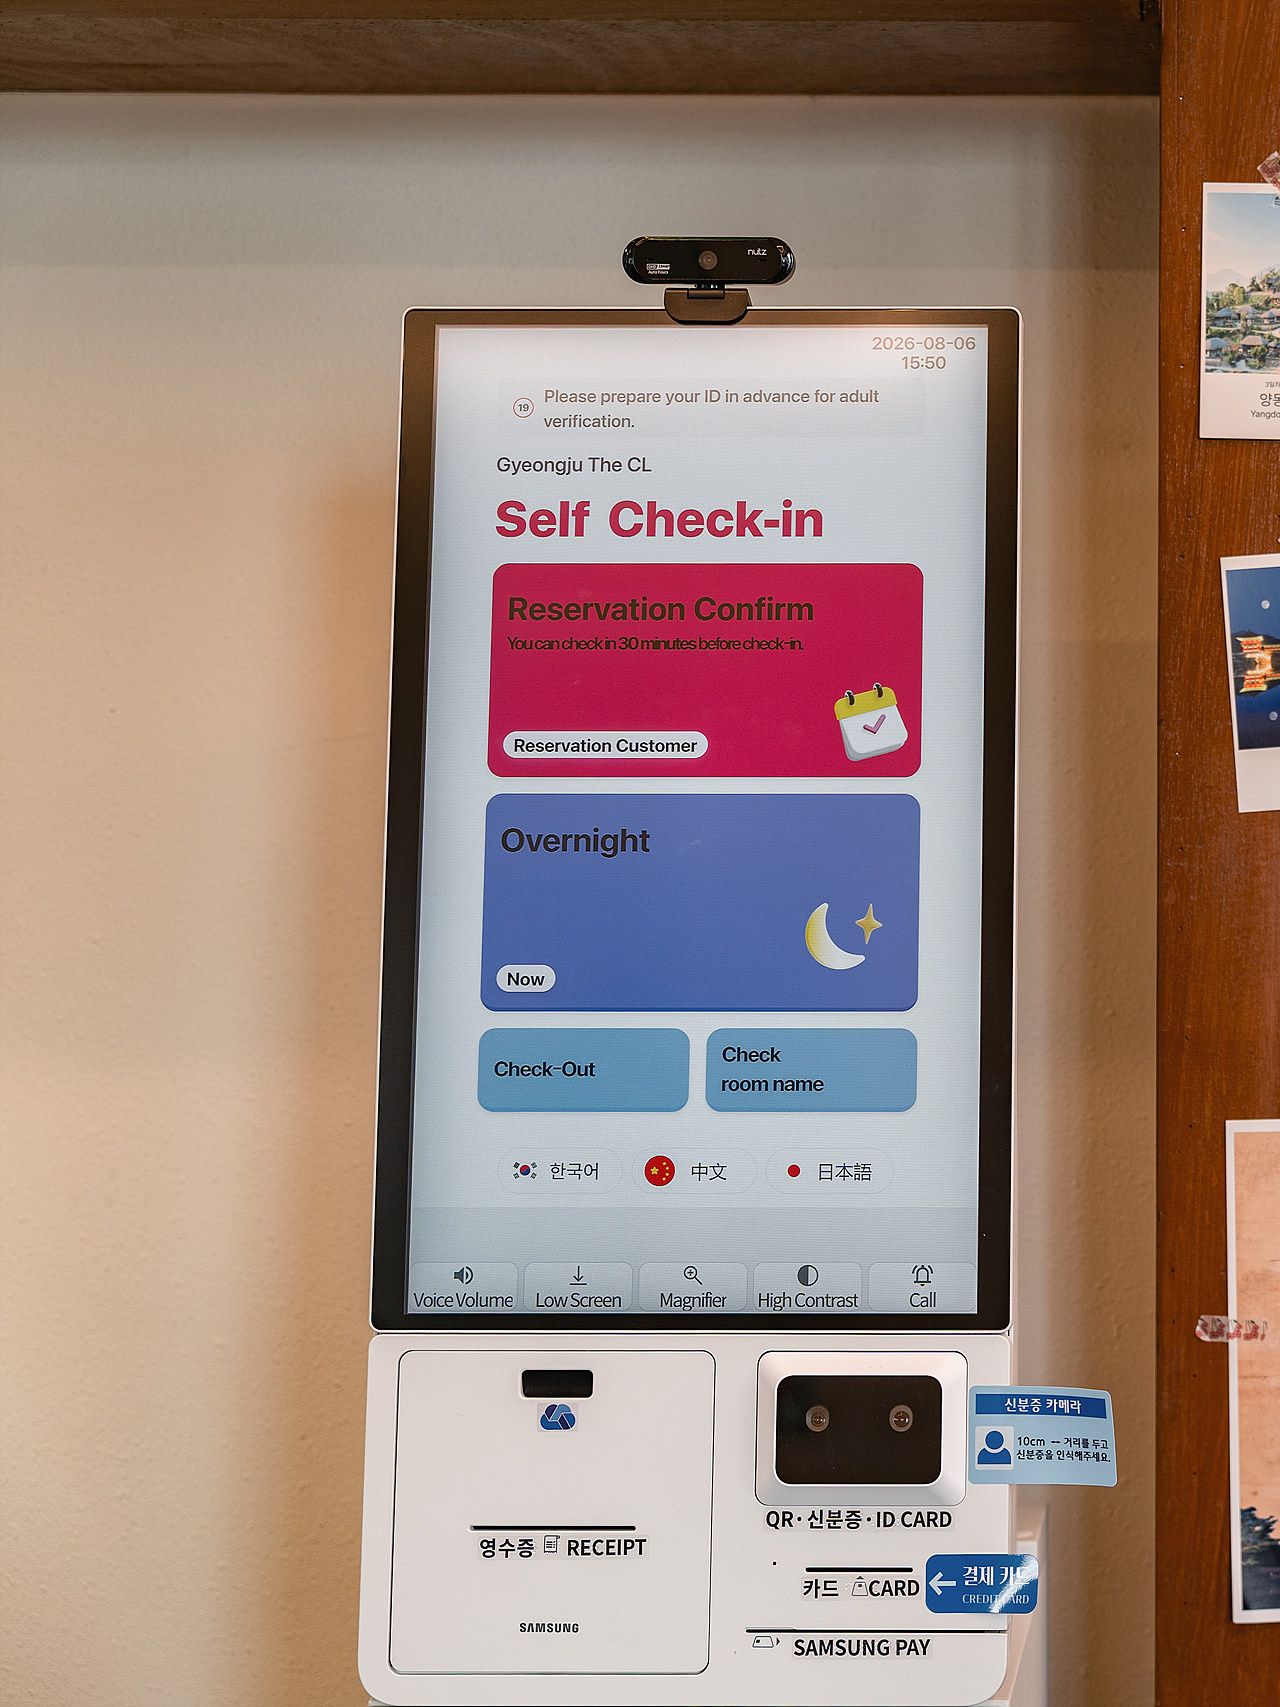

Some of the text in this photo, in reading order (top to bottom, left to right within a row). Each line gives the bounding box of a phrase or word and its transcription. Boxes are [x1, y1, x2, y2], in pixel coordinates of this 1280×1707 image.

[748, 248, 767, 256] nutz
[872, 336, 976, 351] 2026-08-06
[901, 355, 947, 370] 15:50
[544, 389, 879, 406] Please prepare your ID in advance for adult
[518, 403, 529, 412] 19
[544, 414, 635, 428] verification.
[497, 456, 652, 476] Gyeongju The CL
[496, 500, 824, 538] Self Check-in
[508, 596, 814, 621] Reservation Confirm
[507, 636, 533, 650] You
[534, 640, 560, 650] can
[562, 636, 603, 650] check
[604, 637, 616, 650] in
[618, 637, 638, 650] 30
[640, 637, 696, 650] minutes
[698, 636, 741, 650] before
[514, 738, 697, 754] Reservation Customer
[501, 828, 650, 857] Overnight
[507, 972, 545, 987] Now
[722, 1046, 781, 1063] Check
[494, 1061, 595, 1078] Check-Out
[721, 1078, 824, 1092] room name
[550, 1161, 600, 1182] 한국어
[692, 1162, 727, 1181] 中文
[818, 1162, 872, 1182] 日本語
[414, 1292, 513, 1308] Voice Volume
[536, 1293, 621, 1308] Low Screen
[660, 1292, 726, 1311] Magnifier
[758, 1292, 858, 1311] High Contrast
[909, 1292, 936, 1308] Call
[1004, 1398, 1081, 1414] 신분증 카메라
[1017, 1437, 1108, 1449] 10cm 거리를 두고
[1016, 1450, 1111, 1462] 신분증을 인식해주세요.
[766, 1510, 952, 1530] QR 신분증 ID CARD
[480, 1538, 647, 1558] 영수증 RECEIPT
[963, 1566, 994, 1585] 결제
[802, 1580, 920, 1599] 카드 CARD
[962, 1594, 1029, 1604] CREDIT ARD
[520, 1622, 579, 1633] SAMSUNG
[794, 1638, 931, 1656] SAMSUNG PAY
